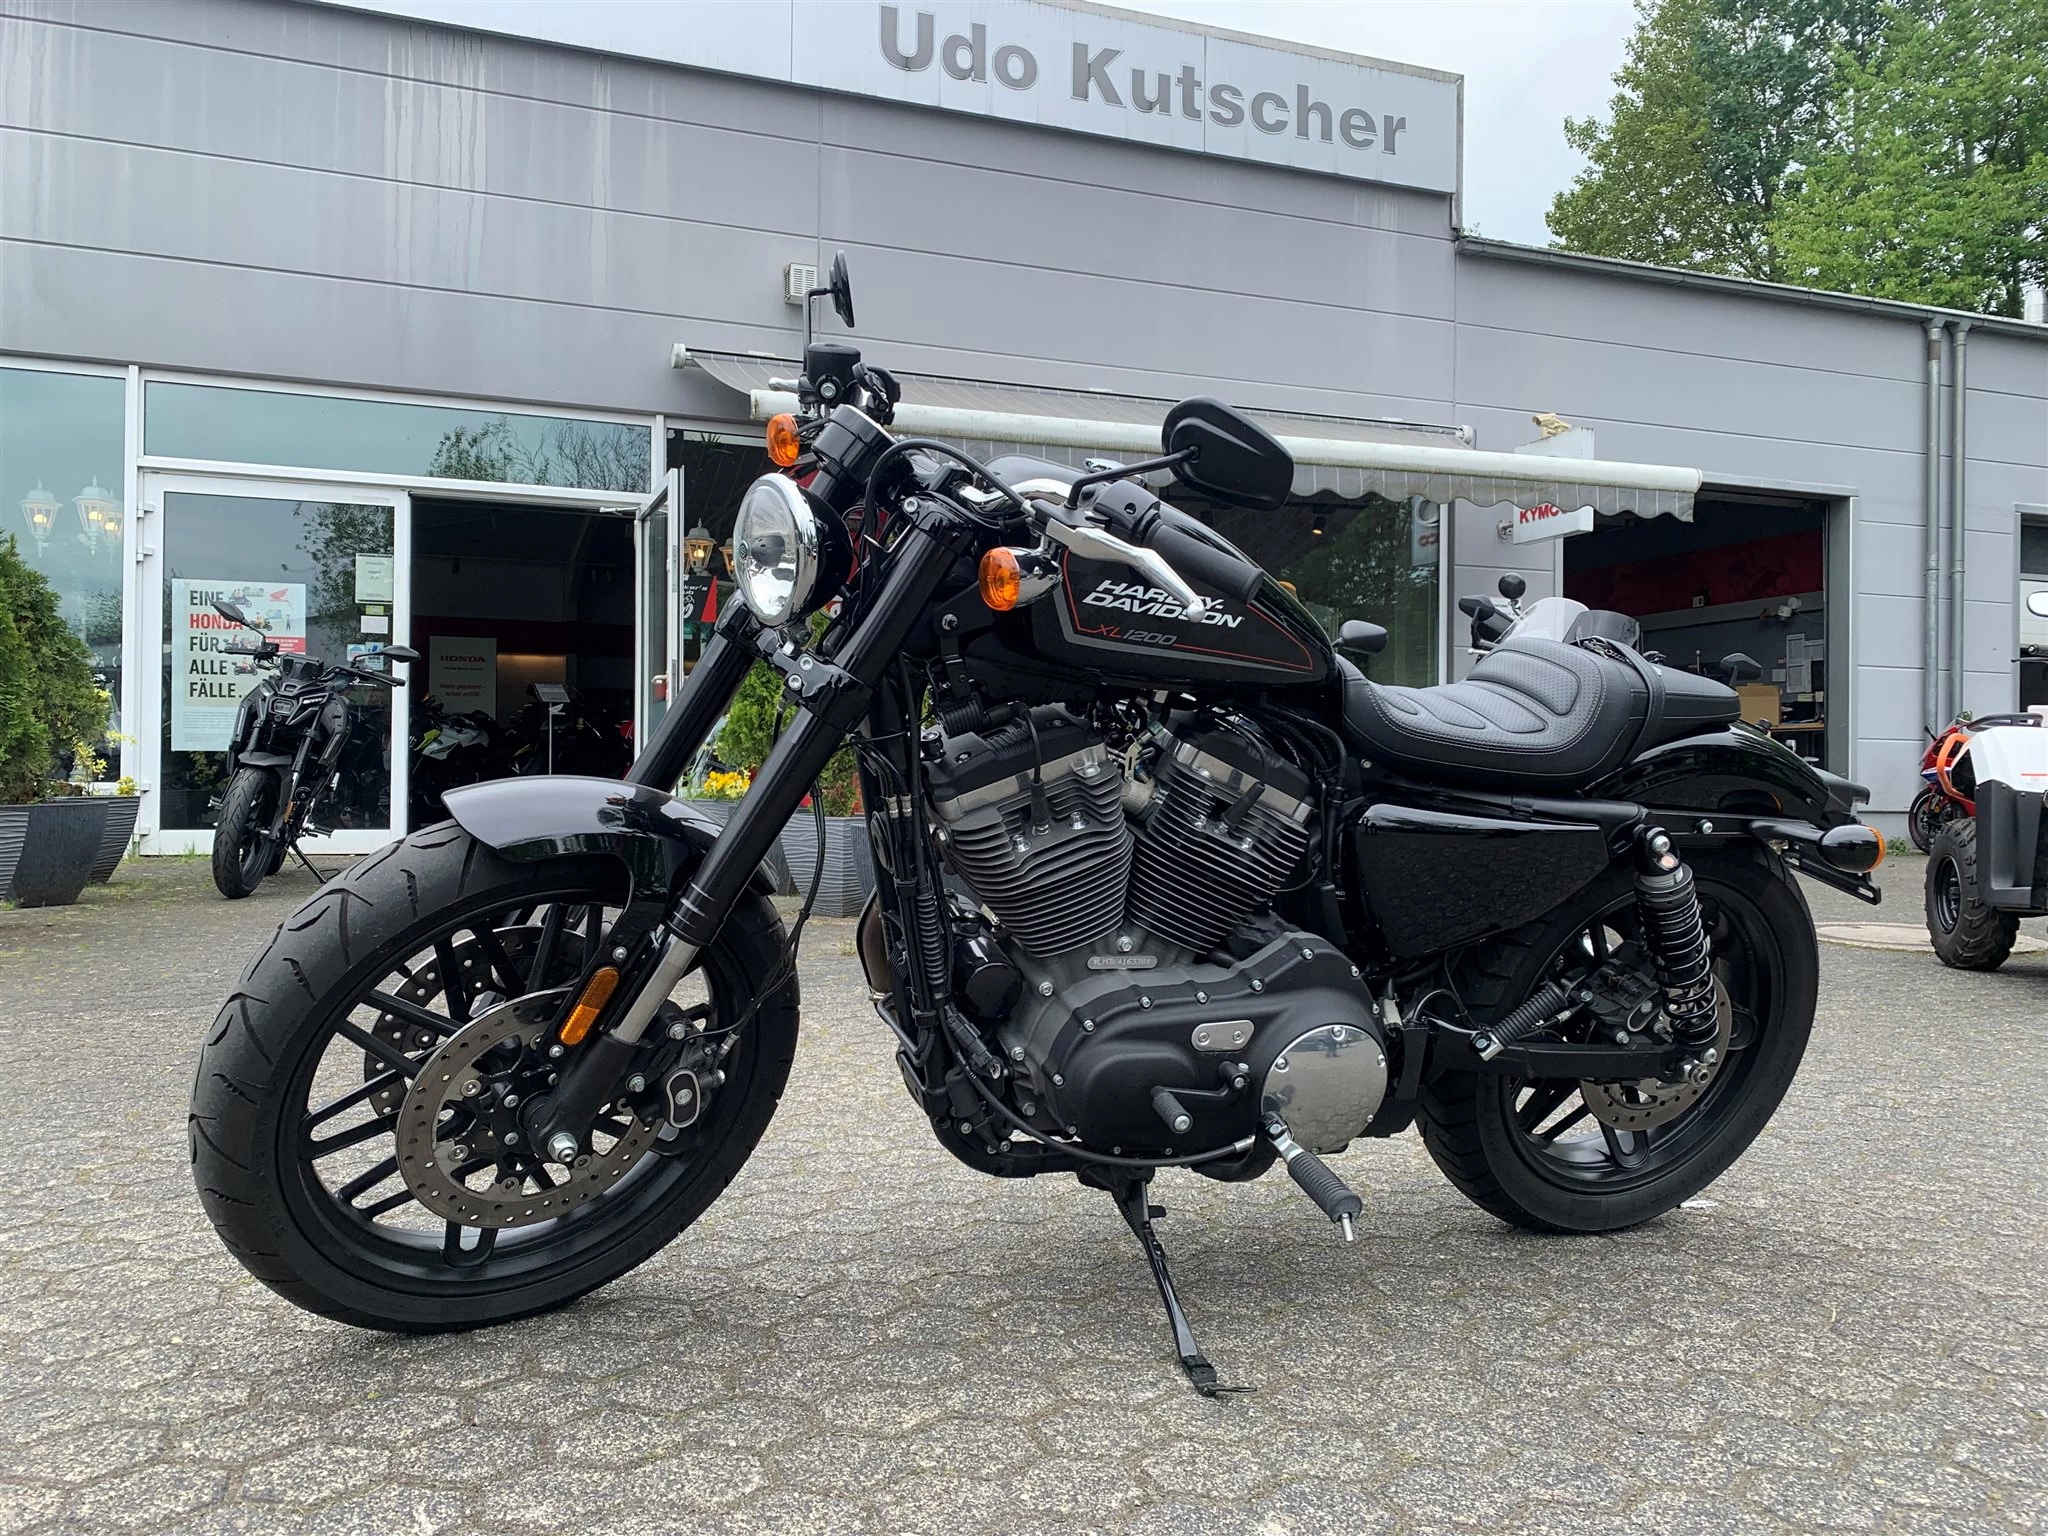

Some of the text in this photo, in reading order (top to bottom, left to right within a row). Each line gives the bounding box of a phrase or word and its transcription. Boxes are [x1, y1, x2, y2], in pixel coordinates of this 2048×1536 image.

[878, 4, 1408, 156] Udo Kutscher
[1519, 503, 1560, 524] KYMC
[189, 590, 224, 606] EINE
[1094, 579, 1225, 610] HARLY-
[189, 613, 243, 630] HONDA
[189, 632, 220, 652] FÜR
[189, 659, 228, 675] ALLE
[439, 655, 487, 663] HONDA
